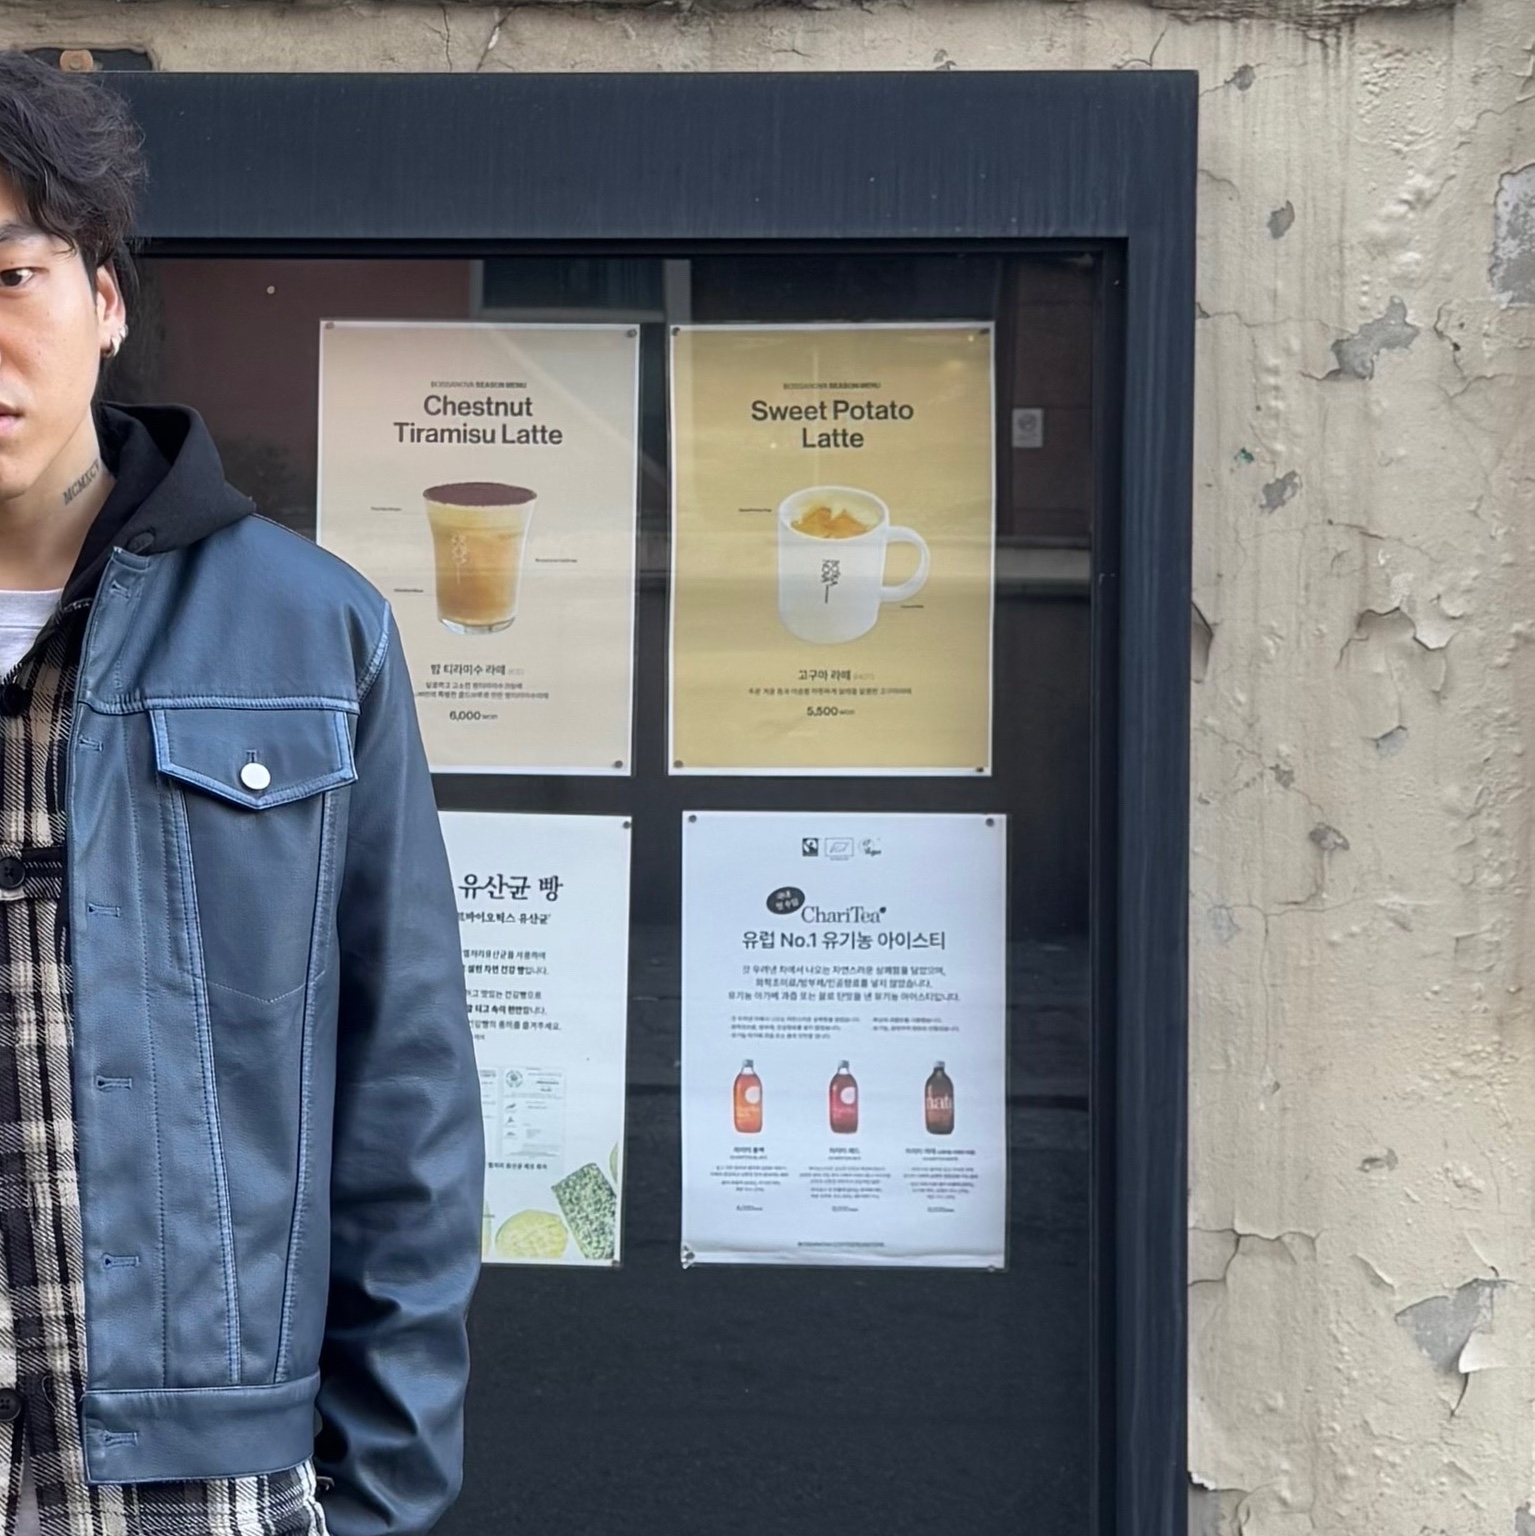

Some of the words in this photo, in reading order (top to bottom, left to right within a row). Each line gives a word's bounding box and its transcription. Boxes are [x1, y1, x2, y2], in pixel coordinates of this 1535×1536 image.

[423, 394, 533, 417] Chestnut
[751, 400, 828, 421] Sweet
[833, 400, 915, 421] Potato
[393, 421, 496, 444] Tiramisu
[501, 423, 563, 445] Latte
[802, 427, 864, 448] Latte
[443, 664, 484, 676] 티라미수
[485, 664, 506, 676] 라떼
[797, 669, 828, 681] 고구마
[830, 669, 852, 681] 라떼
[457, 873, 531, 900] 유산균
[538, 875, 564, 902] 빵
[800, 905, 882, 924] ChariTea
[742, 931, 776, 950] 유럽
[780, 932, 816, 949] No.1
[821, 931, 873, 951] 유기농
[877, 931, 946, 951] 아이스티
